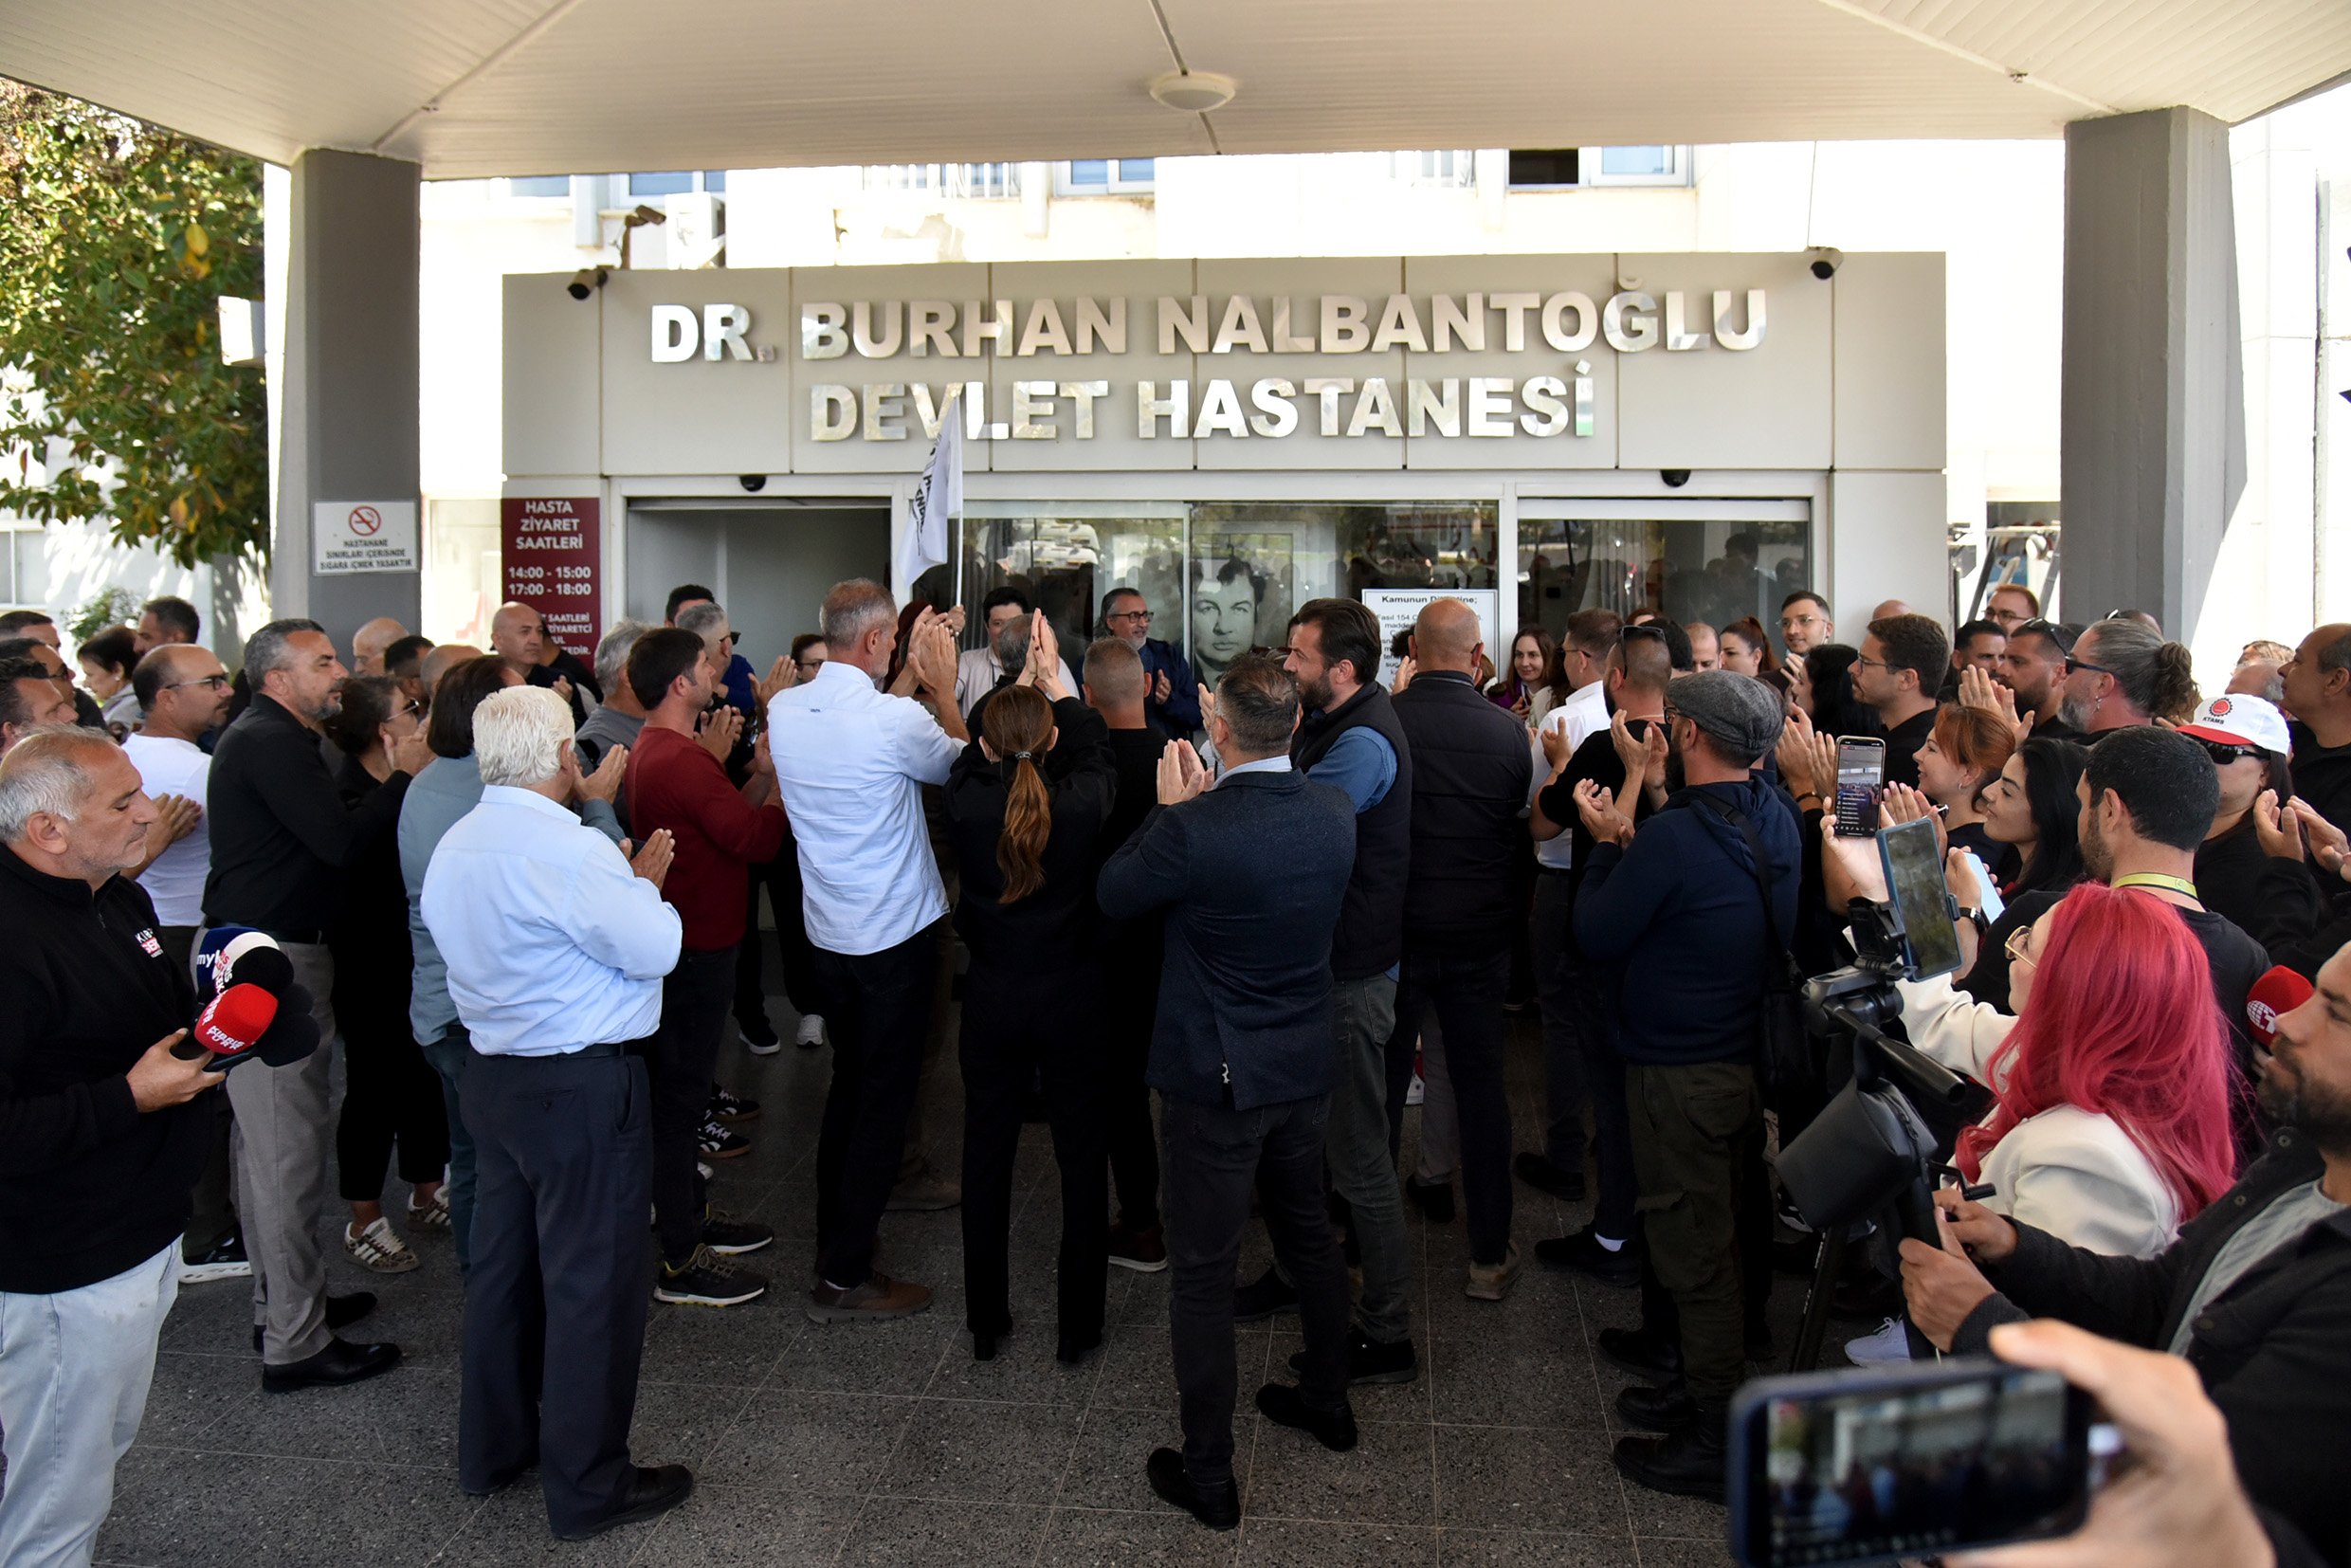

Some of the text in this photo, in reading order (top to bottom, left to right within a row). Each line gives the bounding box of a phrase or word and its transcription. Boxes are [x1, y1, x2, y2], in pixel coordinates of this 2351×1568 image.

[651, 277, 1767, 362] DR. BURHAN NALBANTOĞLU
[811, 359, 1595, 442] DEVLET HASTANESİ
[525, 501, 573, 514] HASTA
[519, 517, 579, 532] ZİYARET
[516, 534, 583, 550] SAATLERİ
[508, 567, 544, 578] 14:00
[556, 567, 592, 578] 15:00
[508, 583, 544, 595] 17:00
[556, 583, 592, 595] 18:00
[1381, 595, 1428, 604] Kamunun
